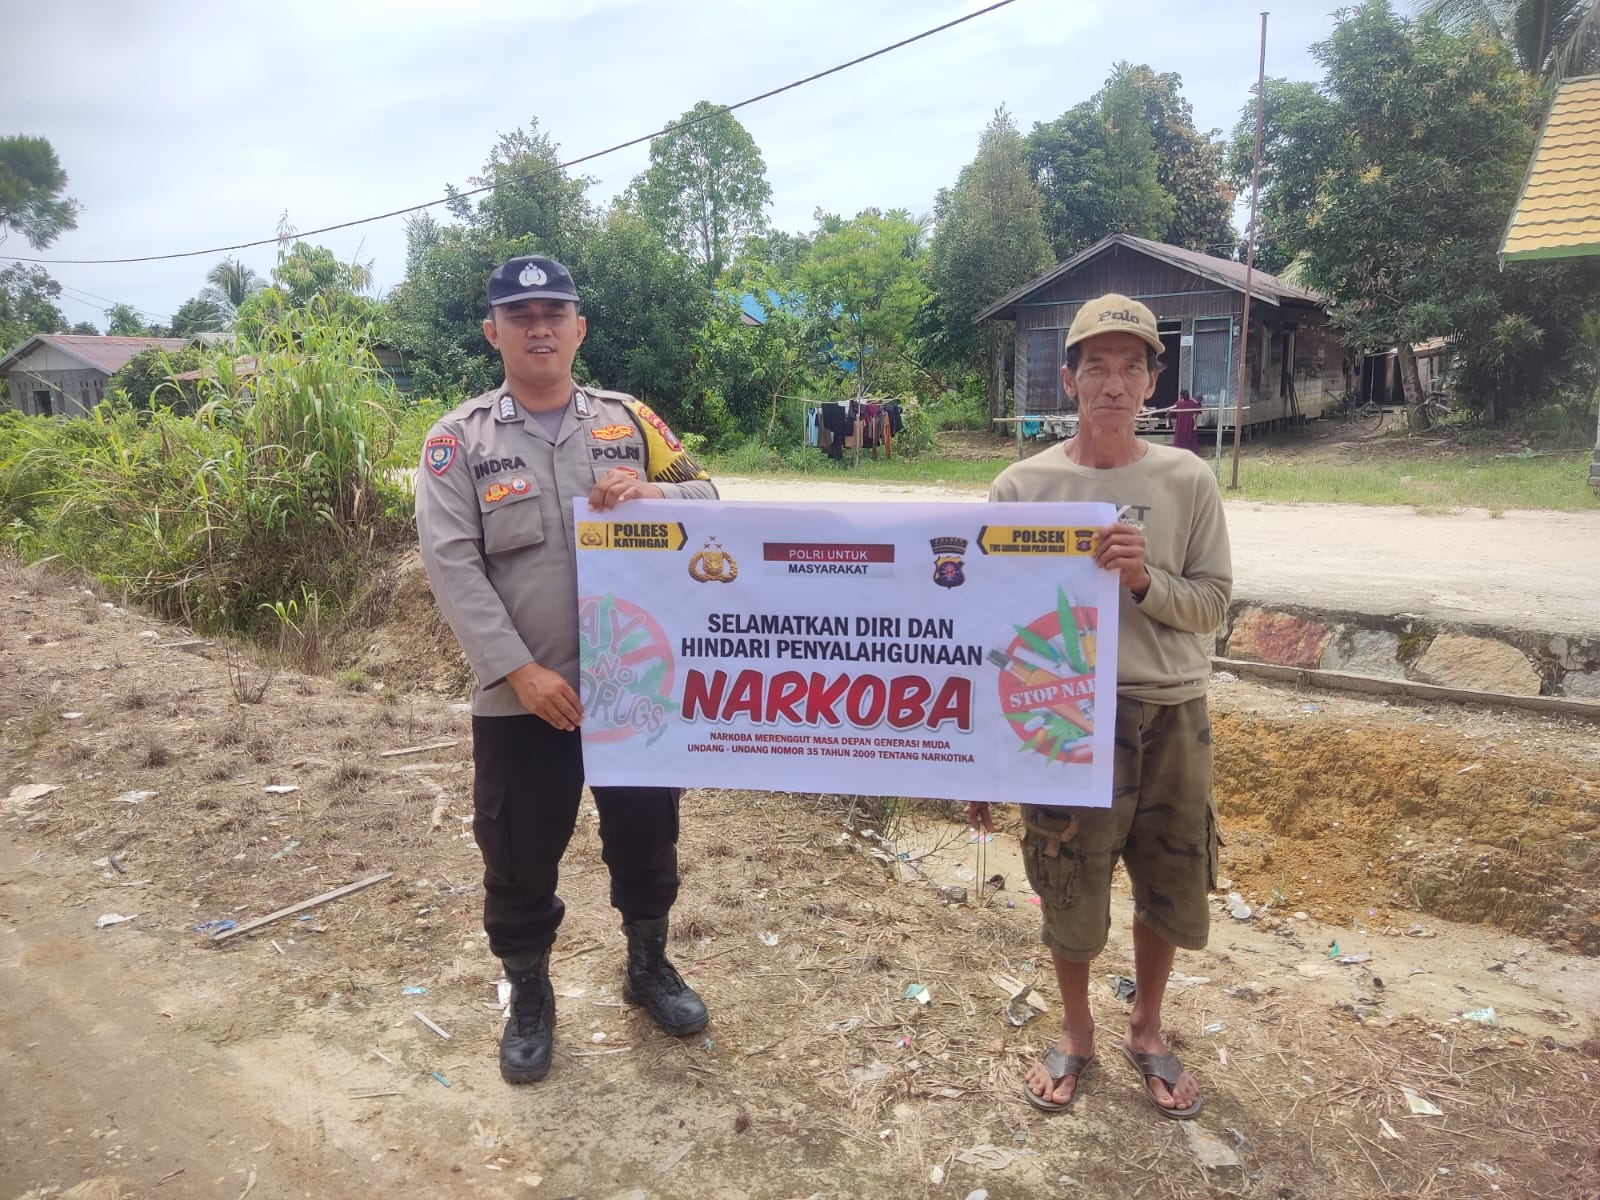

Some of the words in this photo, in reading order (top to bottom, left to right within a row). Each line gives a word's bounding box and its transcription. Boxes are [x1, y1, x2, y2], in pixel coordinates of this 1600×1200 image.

[591, 445, 640, 461] POLRI
[474, 455, 526, 480] INDRA
[614, 524, 668, 537] POLRES
[1012, 530, 1065, 543] POLSEK
[614, 537, 668, 548] KATINGAN
[789, 549, 824, 560] POLRI
[828, 550, 868, 560] UNTUK
[788, 564, 869, 574] MASYARAKAT
[708, 613, 849, 636] SELAMATKAN
[855, 616, 900, 638] DIRI
[908, 618, 954, 640] DAN
[681, 637, 769, 659] HINDARI
[776, 639, 983, 666] PENYALAHGUNAAN
[681, 668, 972, 731] NARKOBA
[1009, 685, 1058, 708] STOP
[710, 732, 752, 742] NARKOBA
[755, 733, 810, 744] MERENGGUT
[813, 736, 839, 745] MASA
[841, 737, 872, 746] DEPAN
[874, 738, 920, 748] GENERASI
[922, 740, 951, 749] MUDA
[688, 743, 724, 752] UNDANG
[731, 744, 768, 754] UNDANG
[771, 745, 804, 755] NOMOR
[807, 747, 819, 756] 35
[821, 748, 850, 757] TAHUN
[852, 749, 876, 758] 2009
[878, 750, 919, 760] TENTANG
[921, 752, 975, 763] NARKOTIKA
